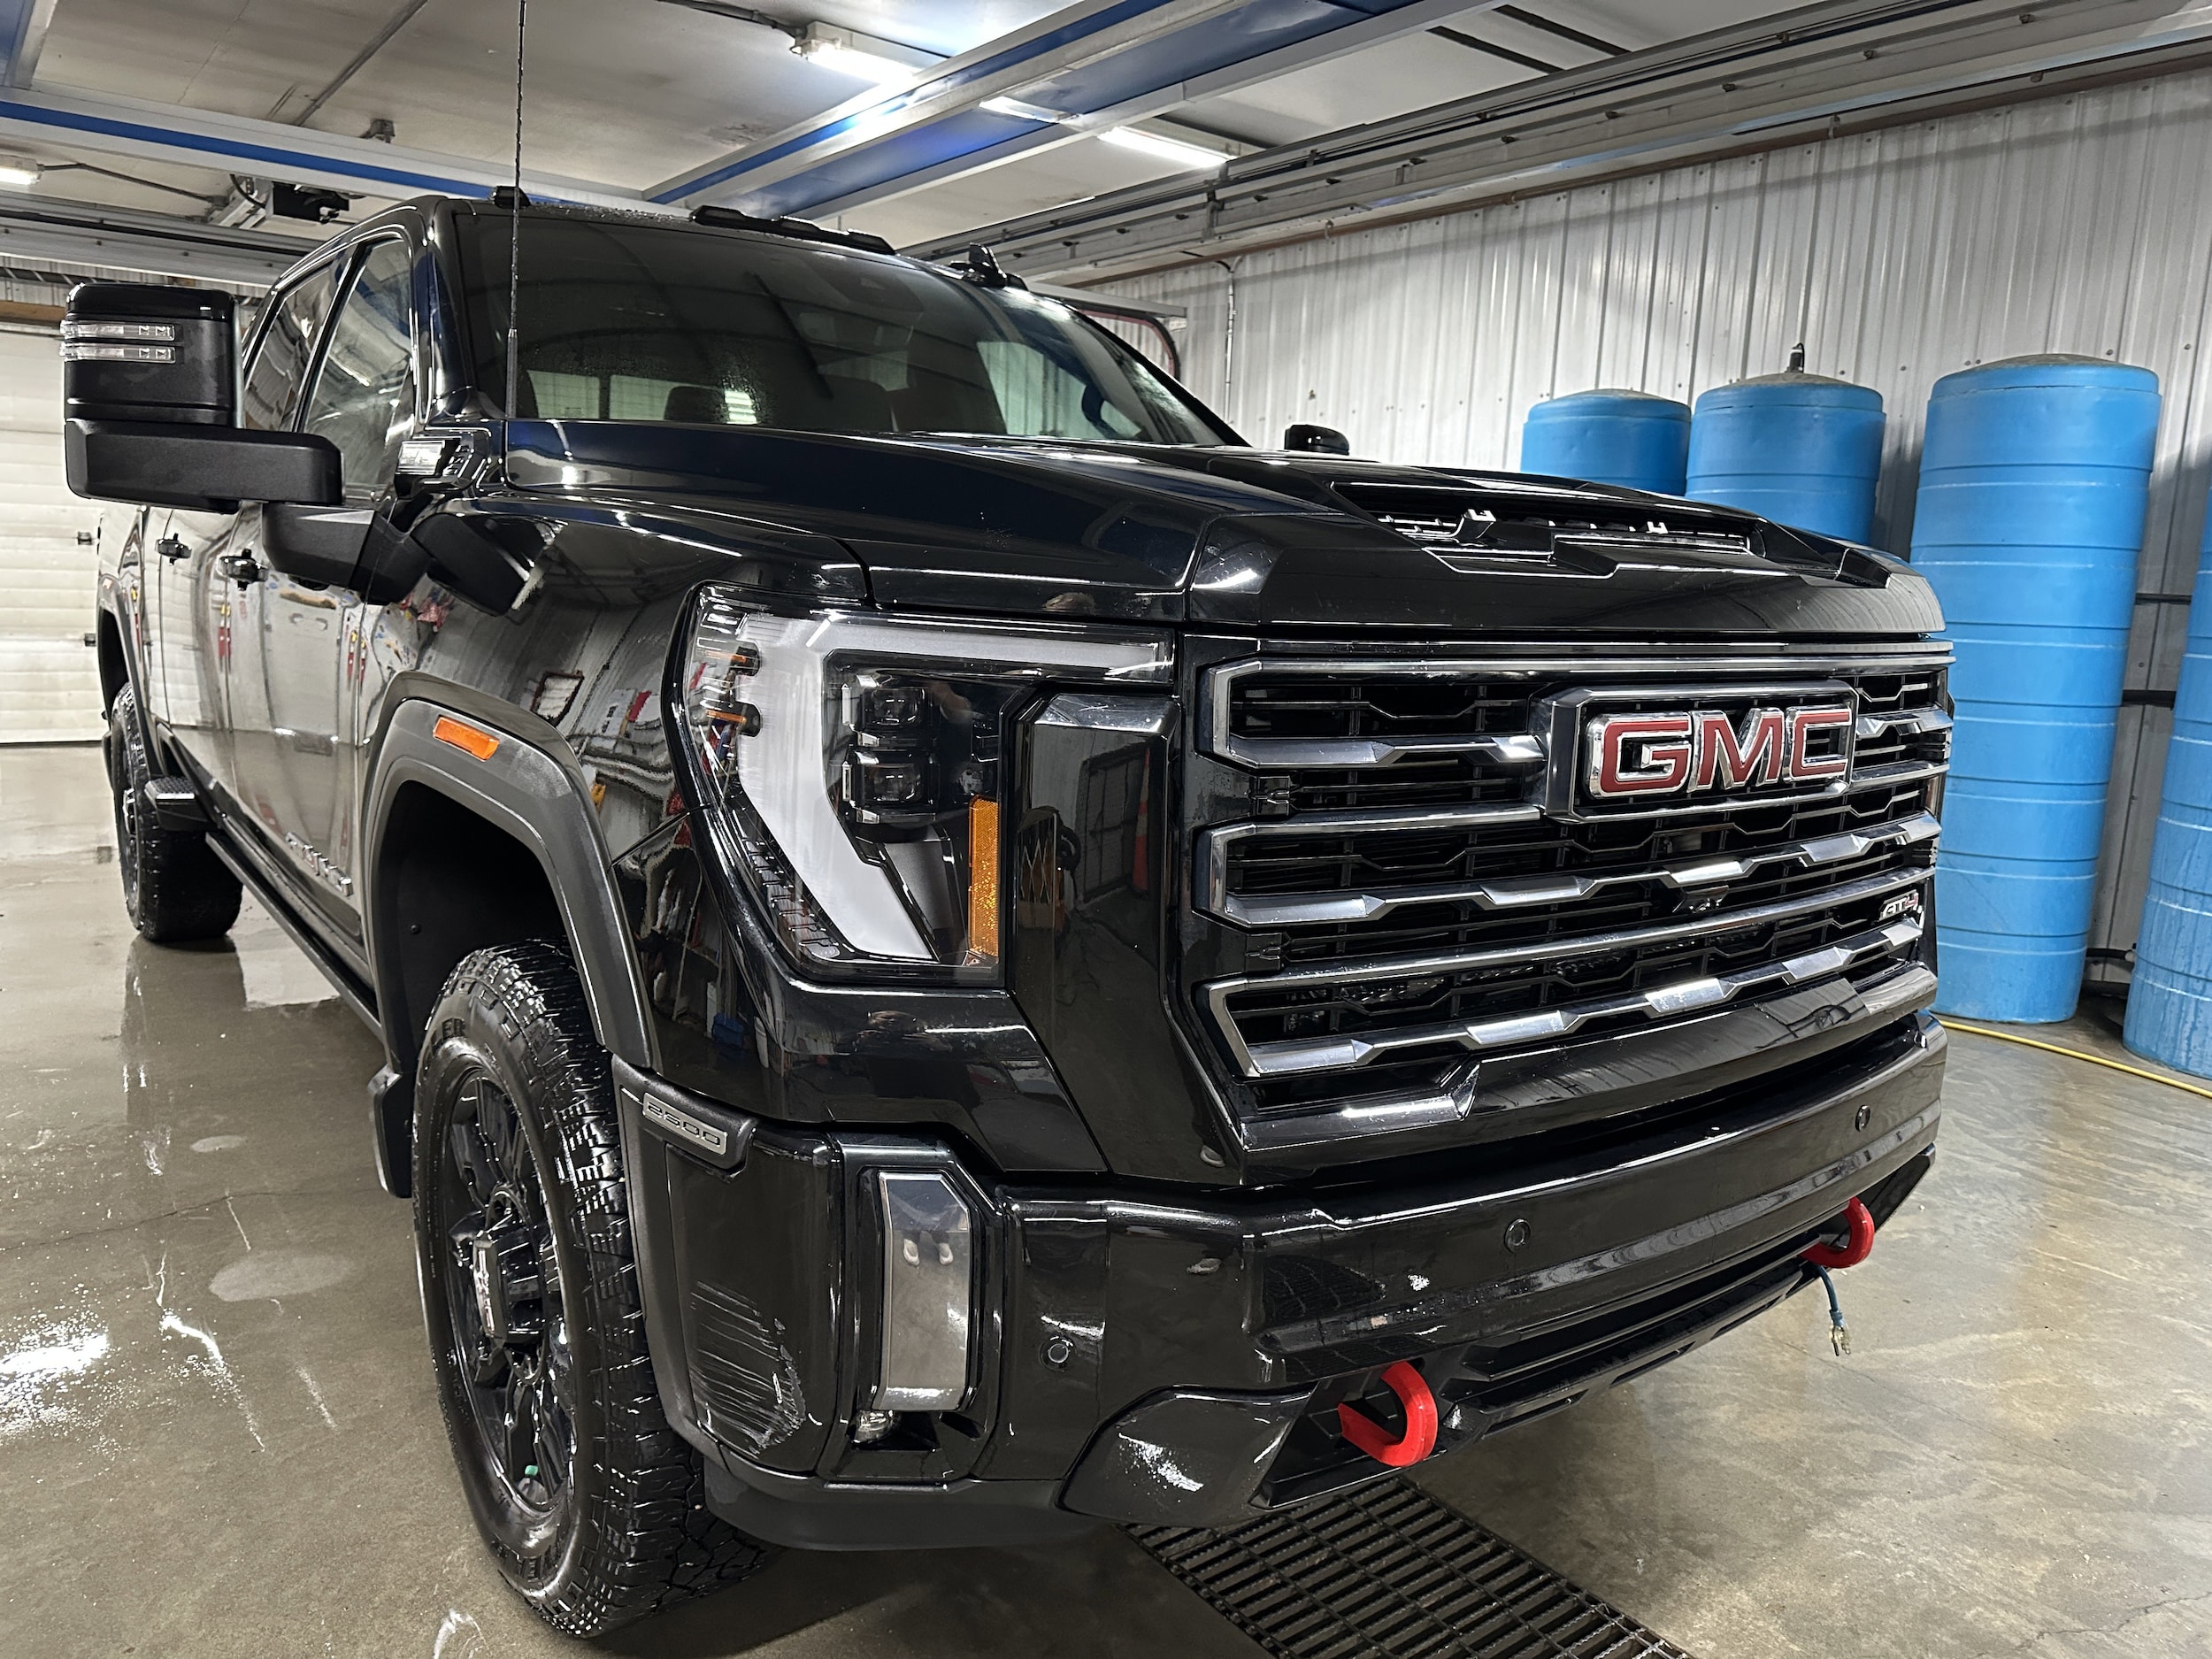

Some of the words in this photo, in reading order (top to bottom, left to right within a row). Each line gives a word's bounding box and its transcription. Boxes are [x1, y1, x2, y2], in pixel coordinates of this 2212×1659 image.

[1586, 707, 1852, 798] GMC
[1881, 891, 1919, 918] AT4
[647, 1102, 721, 1148] 2500
